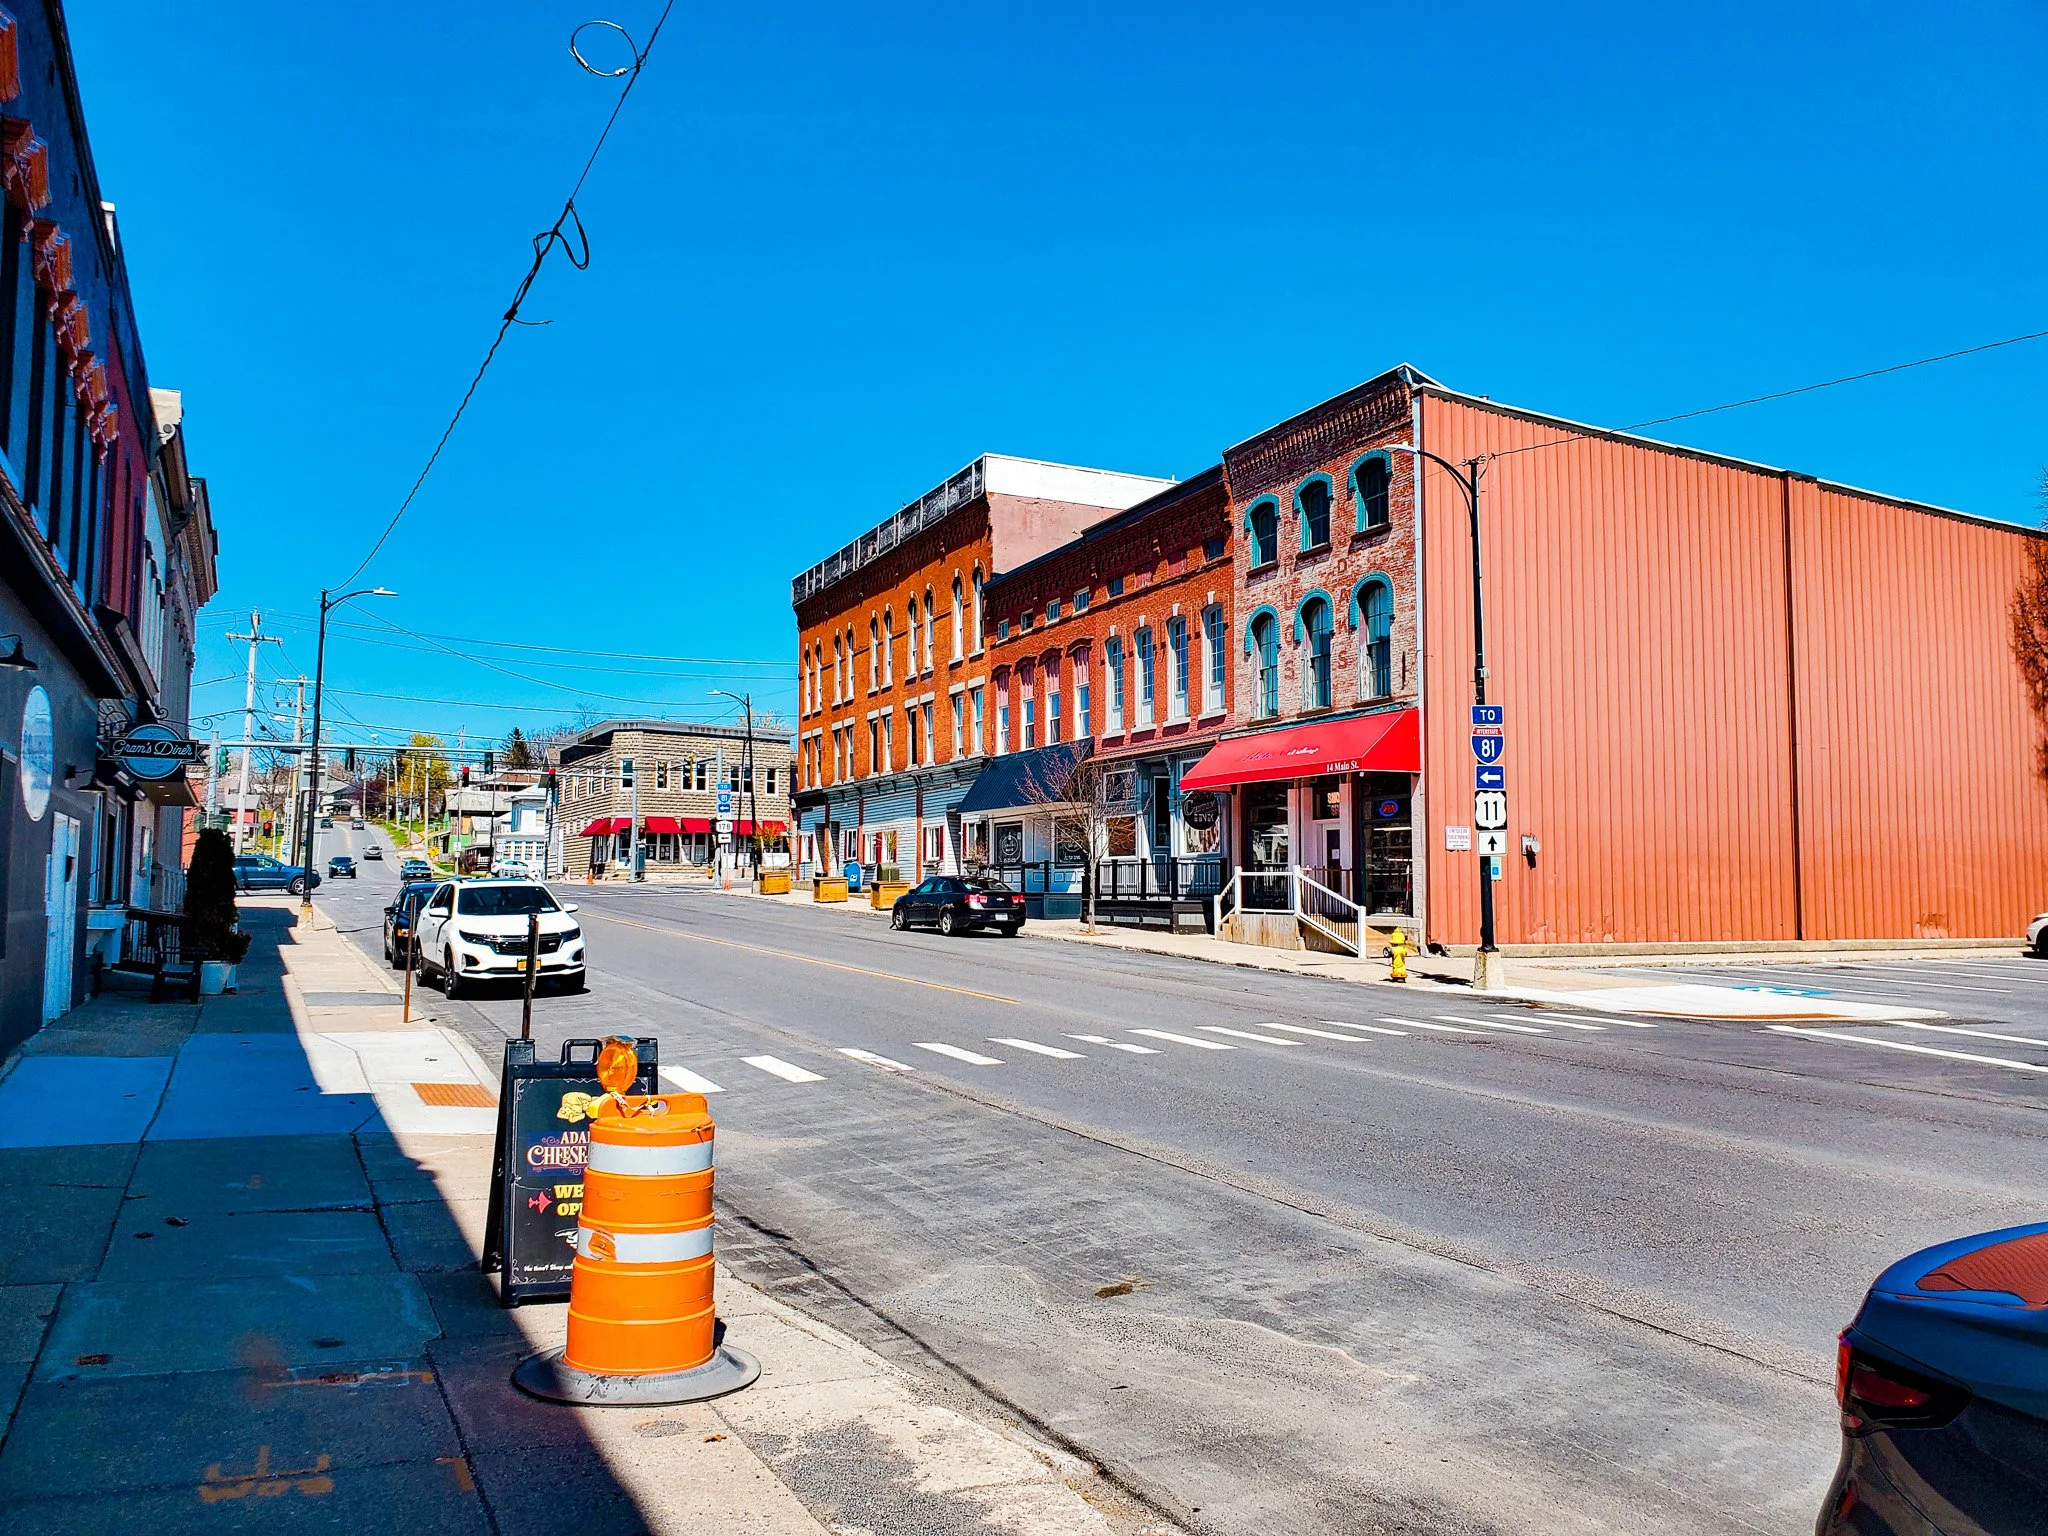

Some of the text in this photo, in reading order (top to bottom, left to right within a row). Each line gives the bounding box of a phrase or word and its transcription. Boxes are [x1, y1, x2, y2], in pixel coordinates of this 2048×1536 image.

[1480, 709, 1495, 721] TO
[112, 739, 193, 756] Gram's Diner
[1481, 739, 1495, 757] 81
[1326, 760, 1360, 773] 14 Main St.
[721, 794, 728, 802] 81
[1483, 800, 1498, 821] 11
[561, 1131, 590, 1144] ADA
[527, 1145, 588, 1167] CHEESE
[554, 1184, 584, 1199] WE
[557, 1202, 583, 1216] OP
